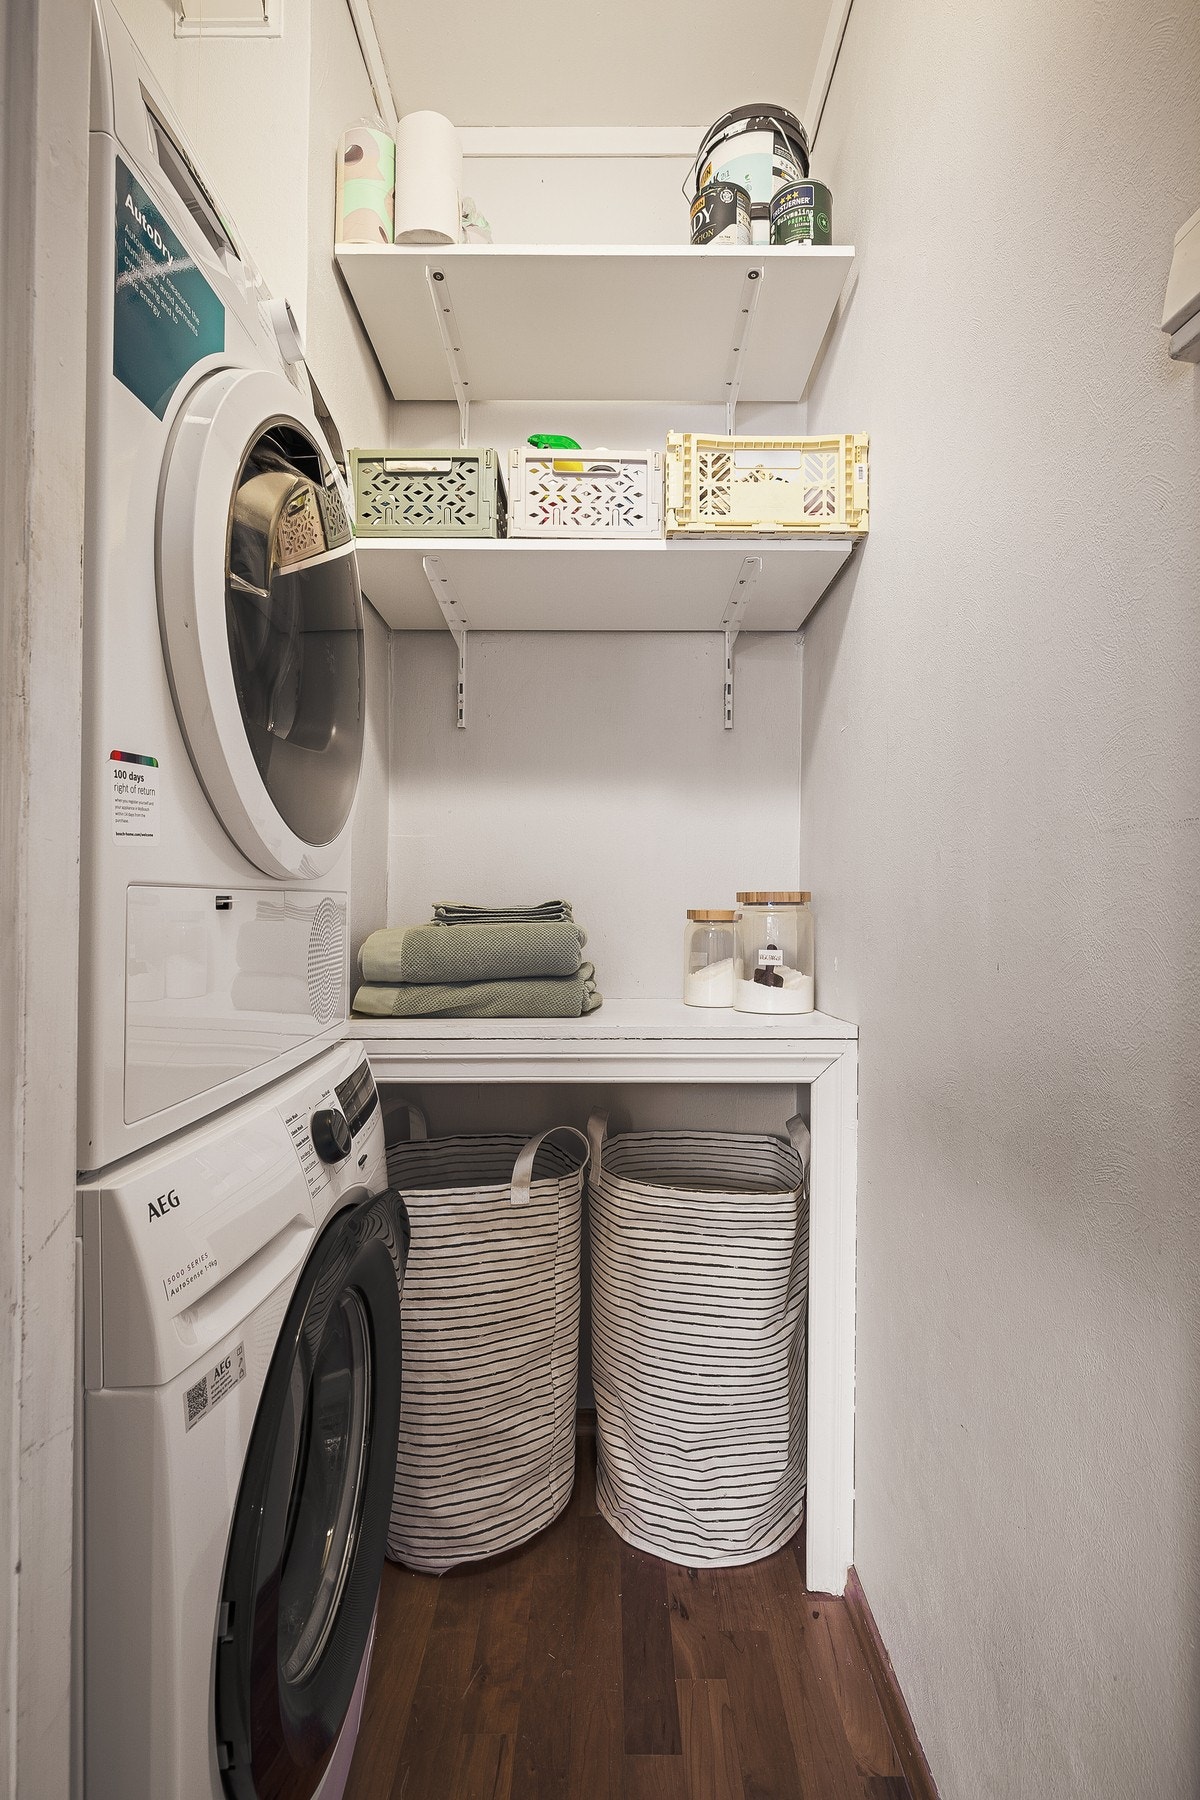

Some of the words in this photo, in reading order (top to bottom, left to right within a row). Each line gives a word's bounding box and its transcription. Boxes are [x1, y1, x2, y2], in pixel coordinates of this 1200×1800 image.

[124, 193, 174, 267] AutoDry
[788, 216, 814, 226] PREMIU
[113, 769, 127, 780] 100
[128, 771, 145, 784] days
[113, 782, 129, 795] right
[129, 784, 137, 794] of
[137, 786, 156, 797] return
[147, 1189, 181, 1223] AEG
[167, 1268, 185, 1285] 5000
[186, 1252, 209, 1272] SERIES
[170, 1269, 204, 1297] AutoSense
[213, 1356, 231, 1381] AEG
